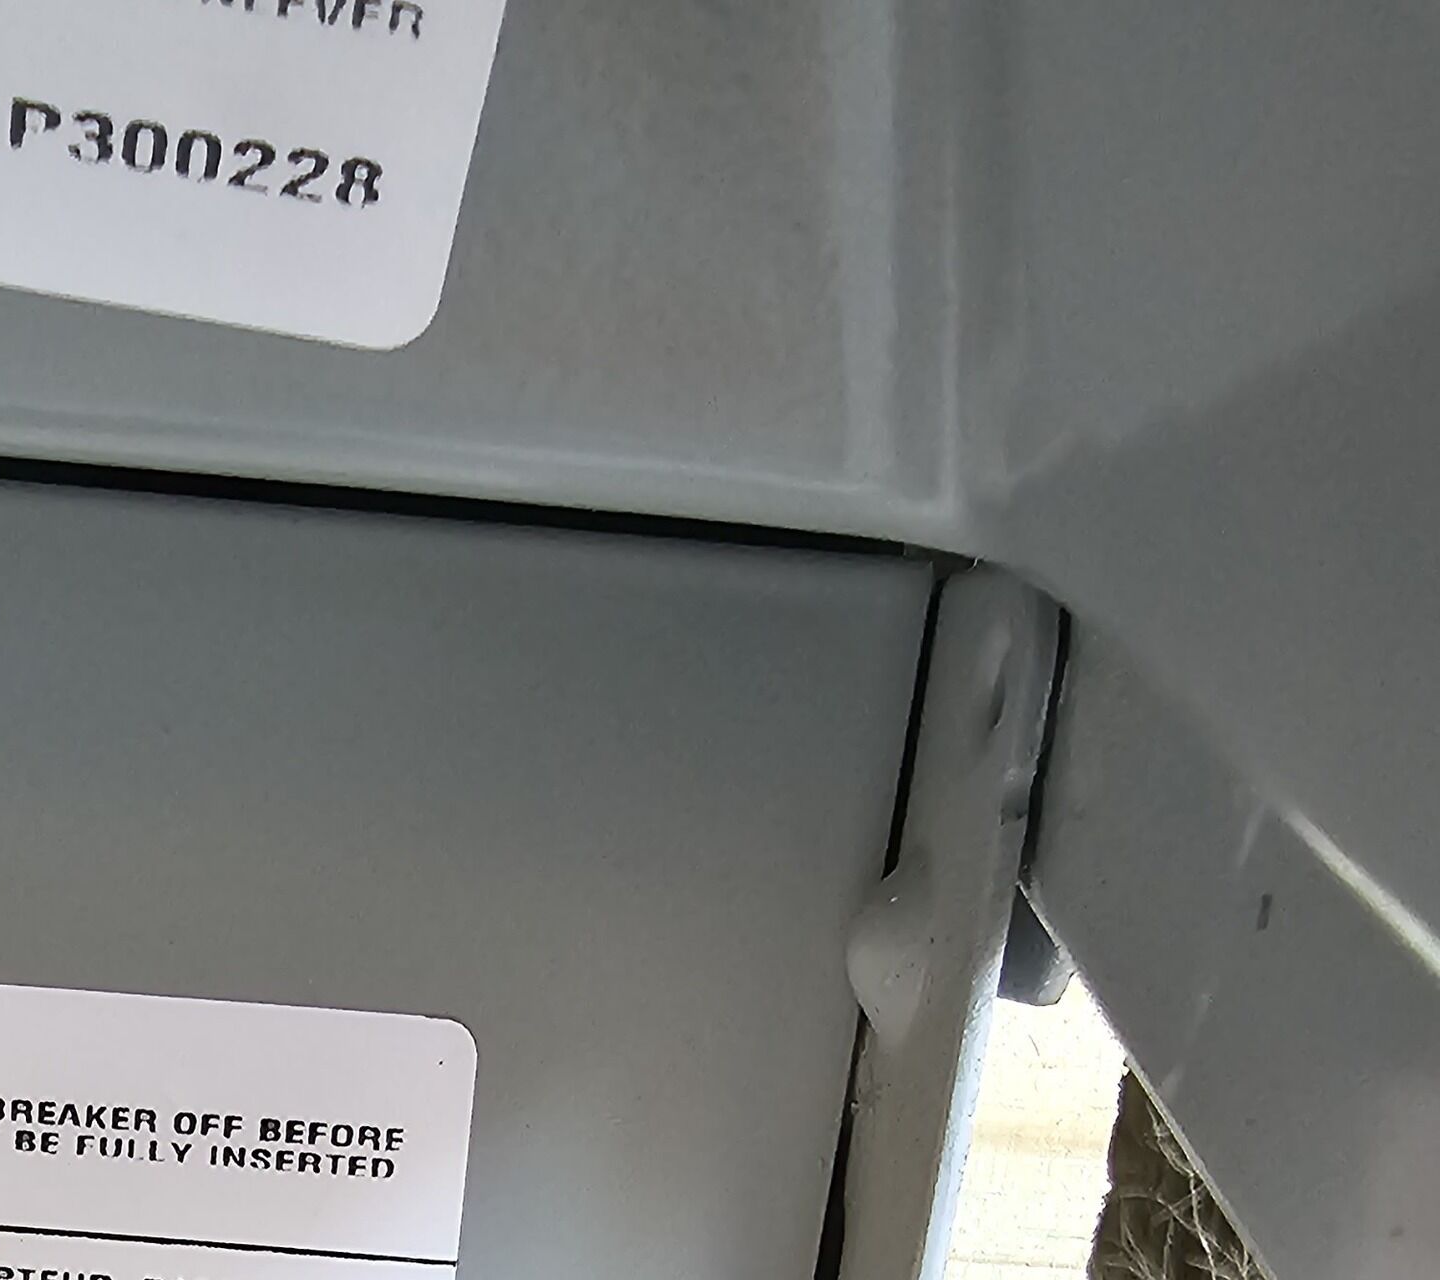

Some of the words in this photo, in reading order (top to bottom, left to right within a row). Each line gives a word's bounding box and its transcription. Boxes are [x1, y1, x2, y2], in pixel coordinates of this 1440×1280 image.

[13, 1128, 61, 1156] BE
[75, 1133, 194, 1165] FULLY
[209, 1136, 396, 1180] INSERTED
[172, 1110, 244, 1140] OFF
[258, 1116, 405, 1152] BEFORE
